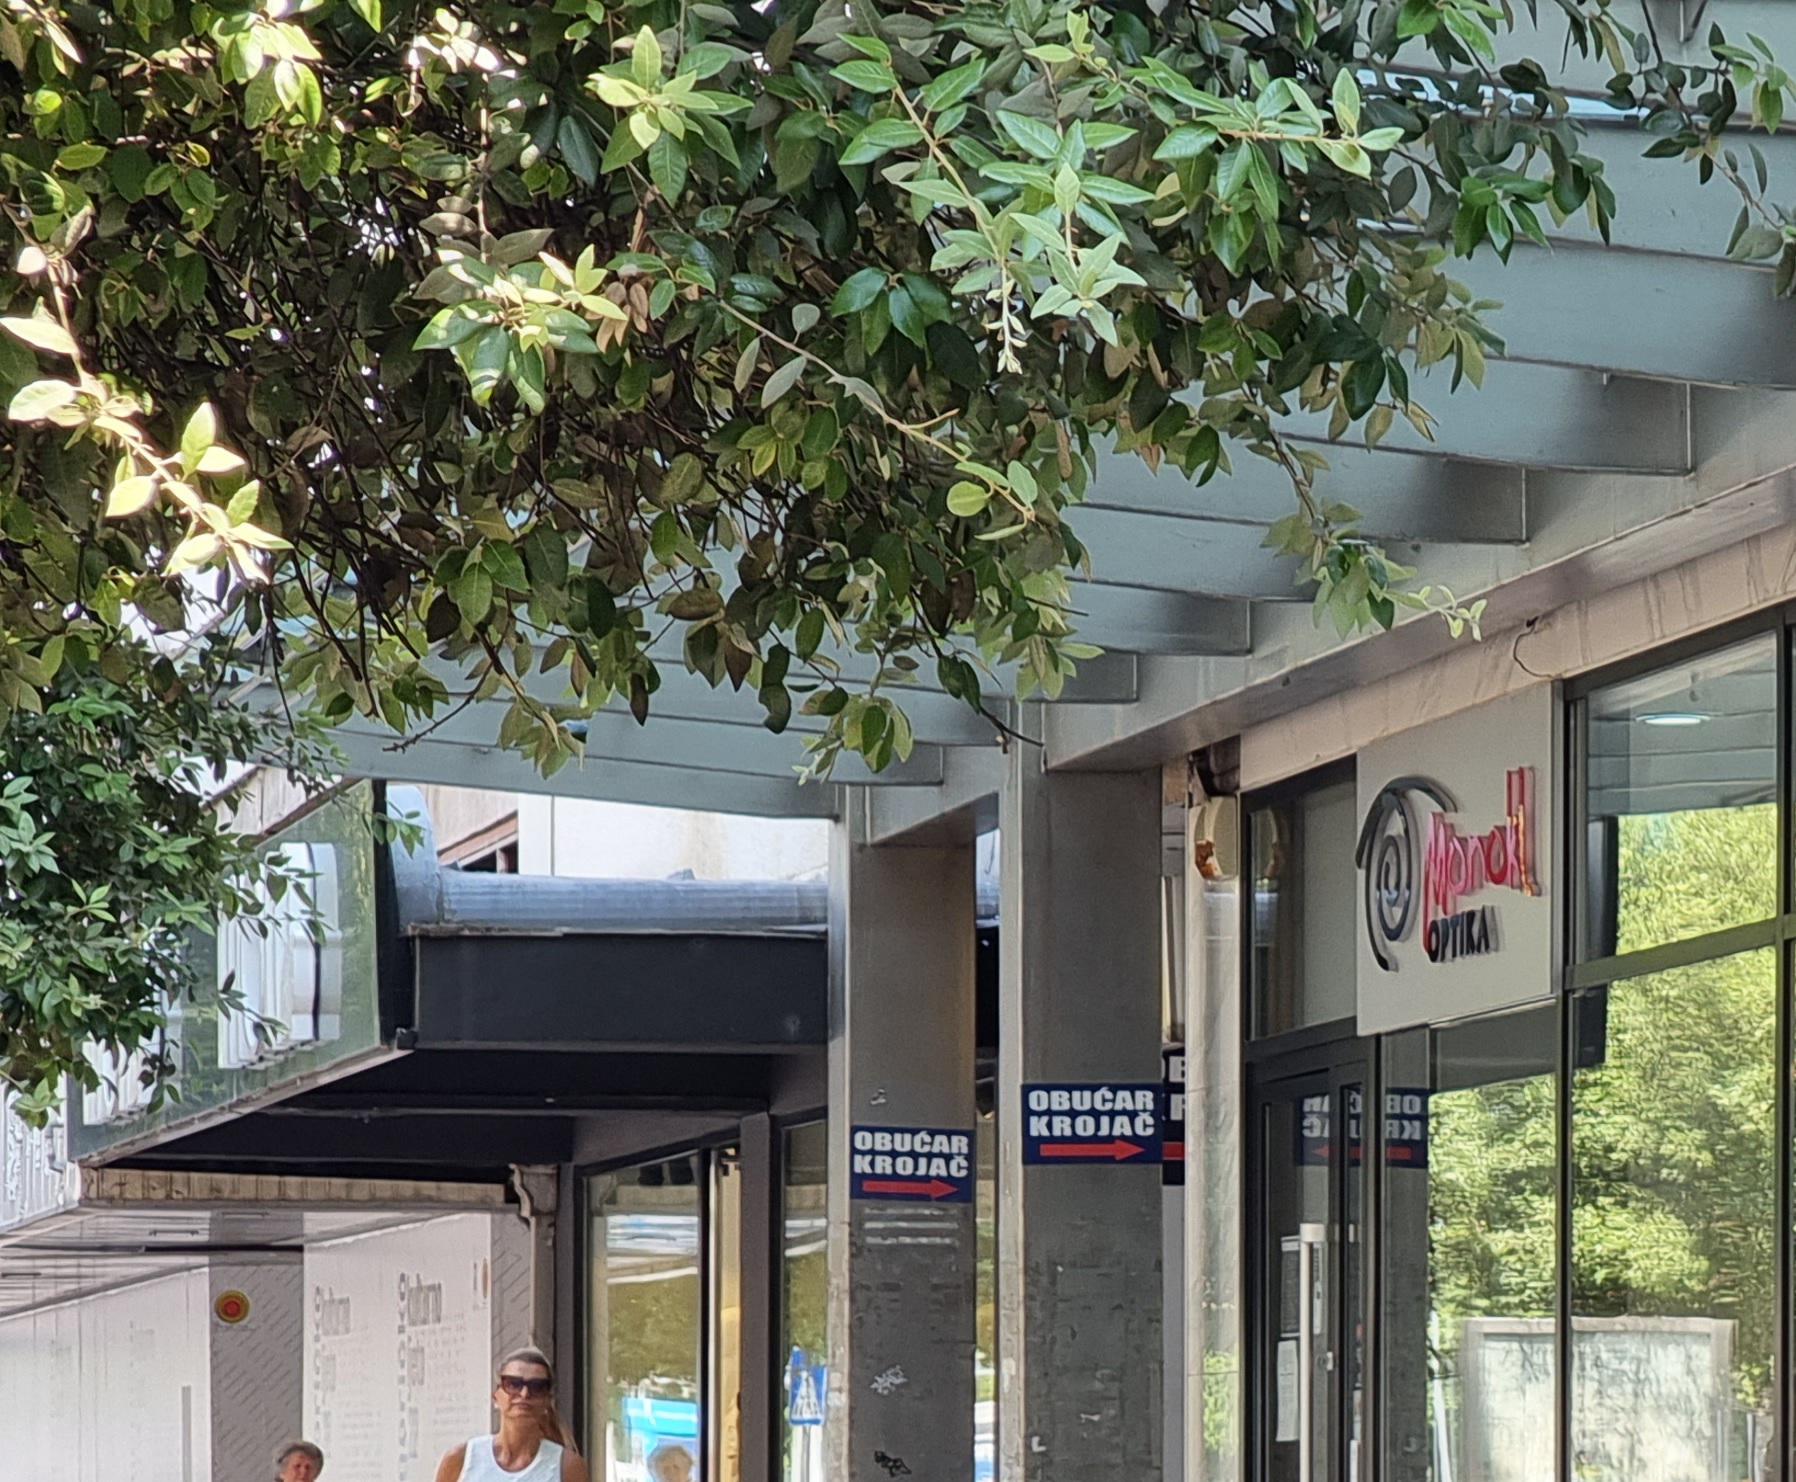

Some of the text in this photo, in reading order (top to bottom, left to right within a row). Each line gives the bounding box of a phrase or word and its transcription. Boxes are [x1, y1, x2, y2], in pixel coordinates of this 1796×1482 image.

[1428, 905, 1497, 963] OPTIKA
[1028, 1086, 1155, 1111] OBUĆAR
[1028, 1110, 1155, 1137] KROJAČ
[853, 1130, 969, 1154] OBUĆAR
[853, 1154, 969, 1178] KROJAČ
